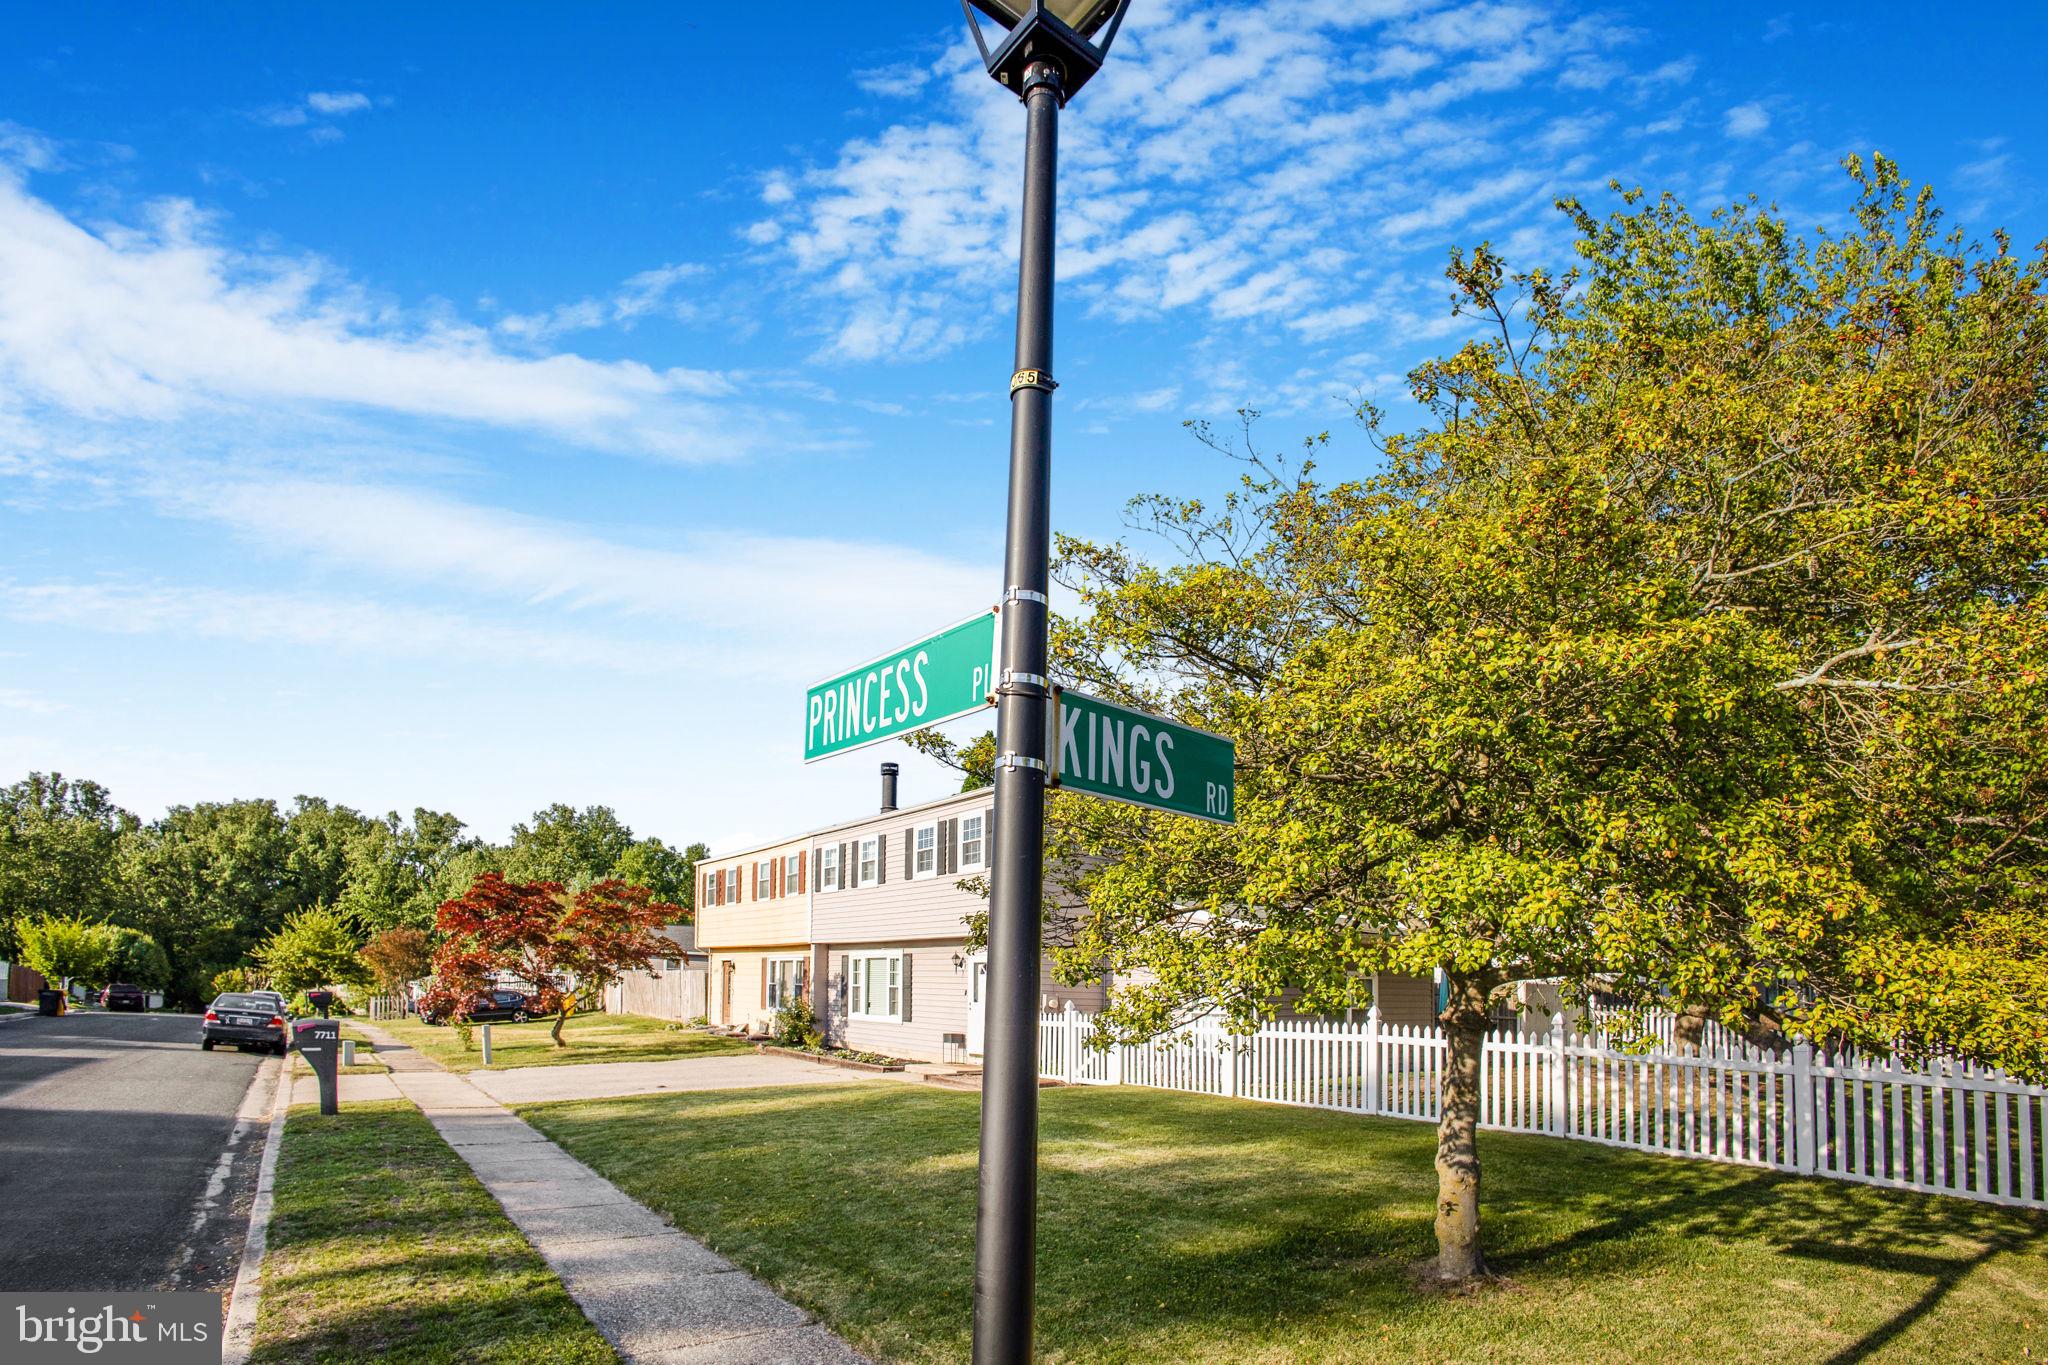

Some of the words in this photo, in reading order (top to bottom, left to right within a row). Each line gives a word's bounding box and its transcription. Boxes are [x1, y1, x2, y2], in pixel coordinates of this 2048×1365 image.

[808, 651, 929, 750] PRINCESS
[1059, 706, 1175, 799] KINGS
[1206, 781, 1228, 816] RD
[314, 1030, 336, 1039] 7711
